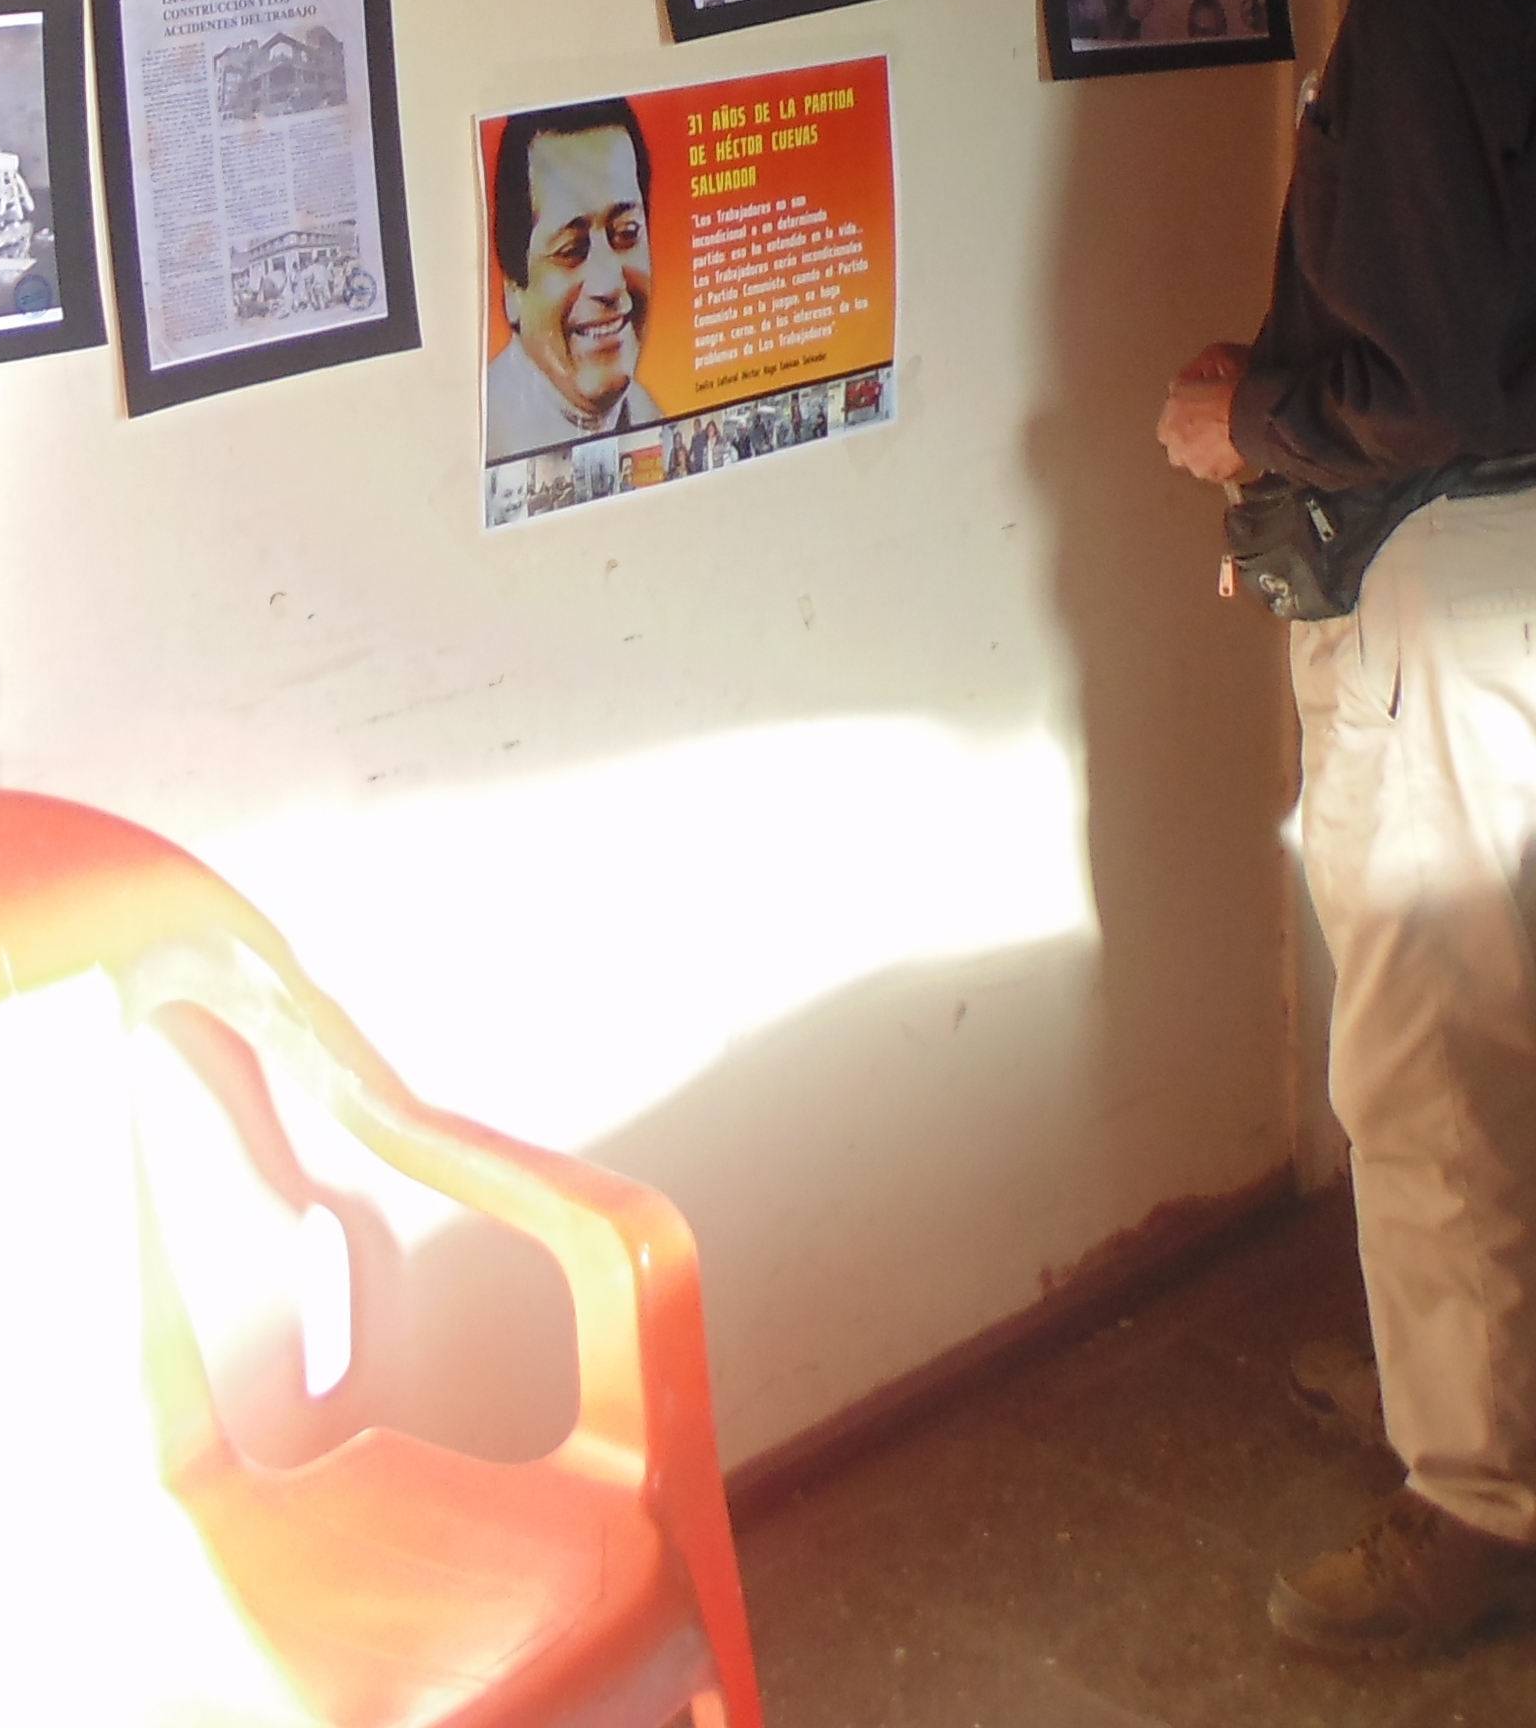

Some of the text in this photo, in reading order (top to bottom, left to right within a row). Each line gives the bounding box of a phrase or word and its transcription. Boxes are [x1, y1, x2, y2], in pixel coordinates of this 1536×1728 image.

[163, 4, 317, 38] ACCIDENTES DEL TRABAJO
[687, 87, 855, 137] 31 AÑOS DE LA PARTIDA
[689, 124, 818, 167] DE HÉCTOR CUEVAS
[691, 166, 756, 198] SALVADOR
[716, 202, 772, 223] Trabajadores
[775, 199, 787, 211] no
[791, 194, 807, 209] son
[692, 224, 747, 249] incondicional
[777, 208, 828, 231] determinado
[766, 232, 807, 253] entendido
[693, 275, 710, 289] Los
[715, 261, 769, 284] Trabajadores
[801, 241, 863, 264] incondicionales
[708, 287, 739, 305] Partido
[792, 269, 820, 286] cuando
[838, 259, 869, 276] Partido
[694, 306, 738, 329] Comunista
[758, 338, 774, 352] Los
